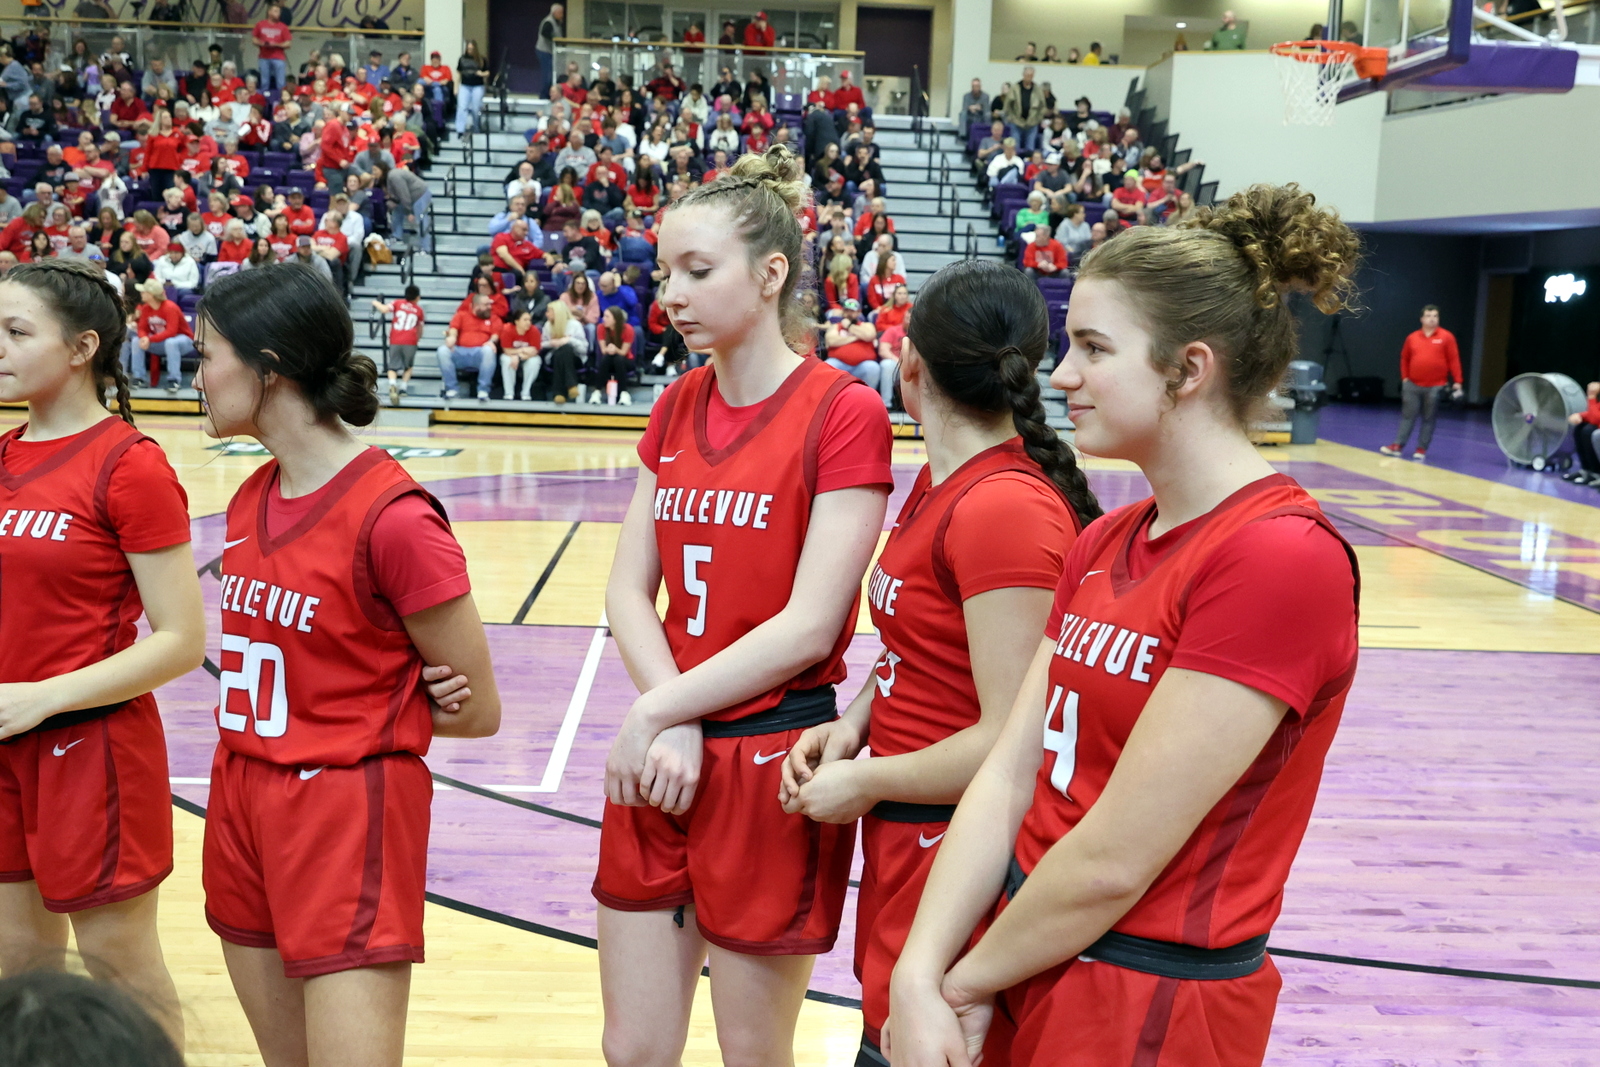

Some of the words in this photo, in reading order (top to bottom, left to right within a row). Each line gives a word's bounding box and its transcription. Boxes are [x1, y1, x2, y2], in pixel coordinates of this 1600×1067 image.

[654, 487, 774, 530] BELLEVUE
[683, 544, 713, 637] 5
[219, 633, 288, 738] 20
[1043, 684, 1080, 802] 4
